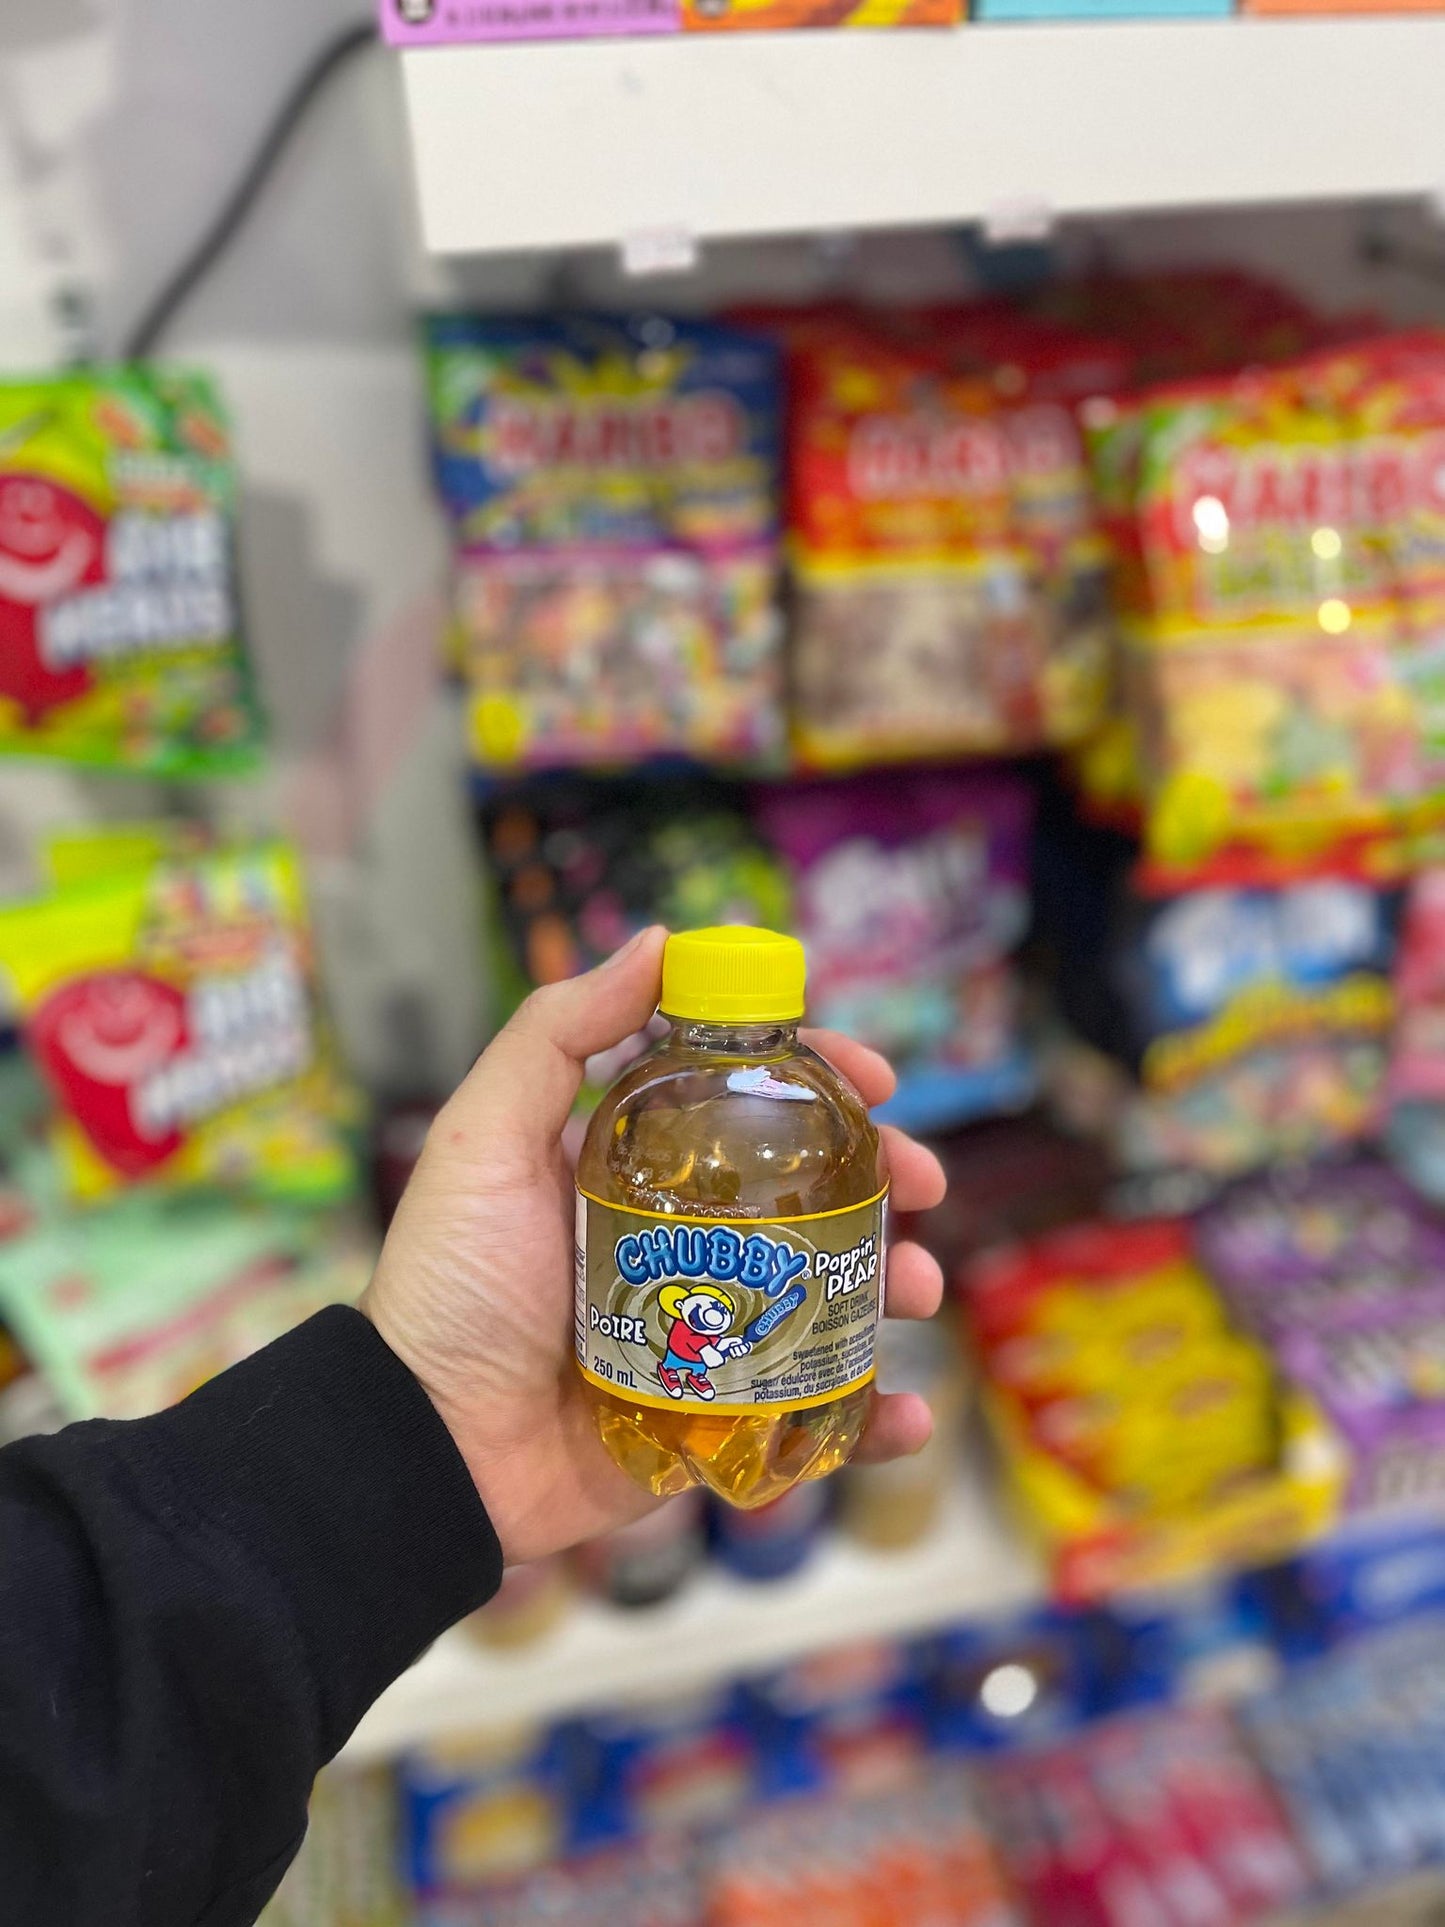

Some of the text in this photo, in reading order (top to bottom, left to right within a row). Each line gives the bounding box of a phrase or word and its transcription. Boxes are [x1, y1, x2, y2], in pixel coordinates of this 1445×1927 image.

[616, 1226, 810, 1297] CHUBBY
[826, 1254, 878, 1301] PEAR
[755, 1292, 799, 1336] CHUBBY
[812, 1310, 850, 1335] BOISSON
[828, 1304, 850, 1317] SOFT
[792, 1341, 834, 1361] sweetened
[594, 1356, 638, 1388] 250 mL
